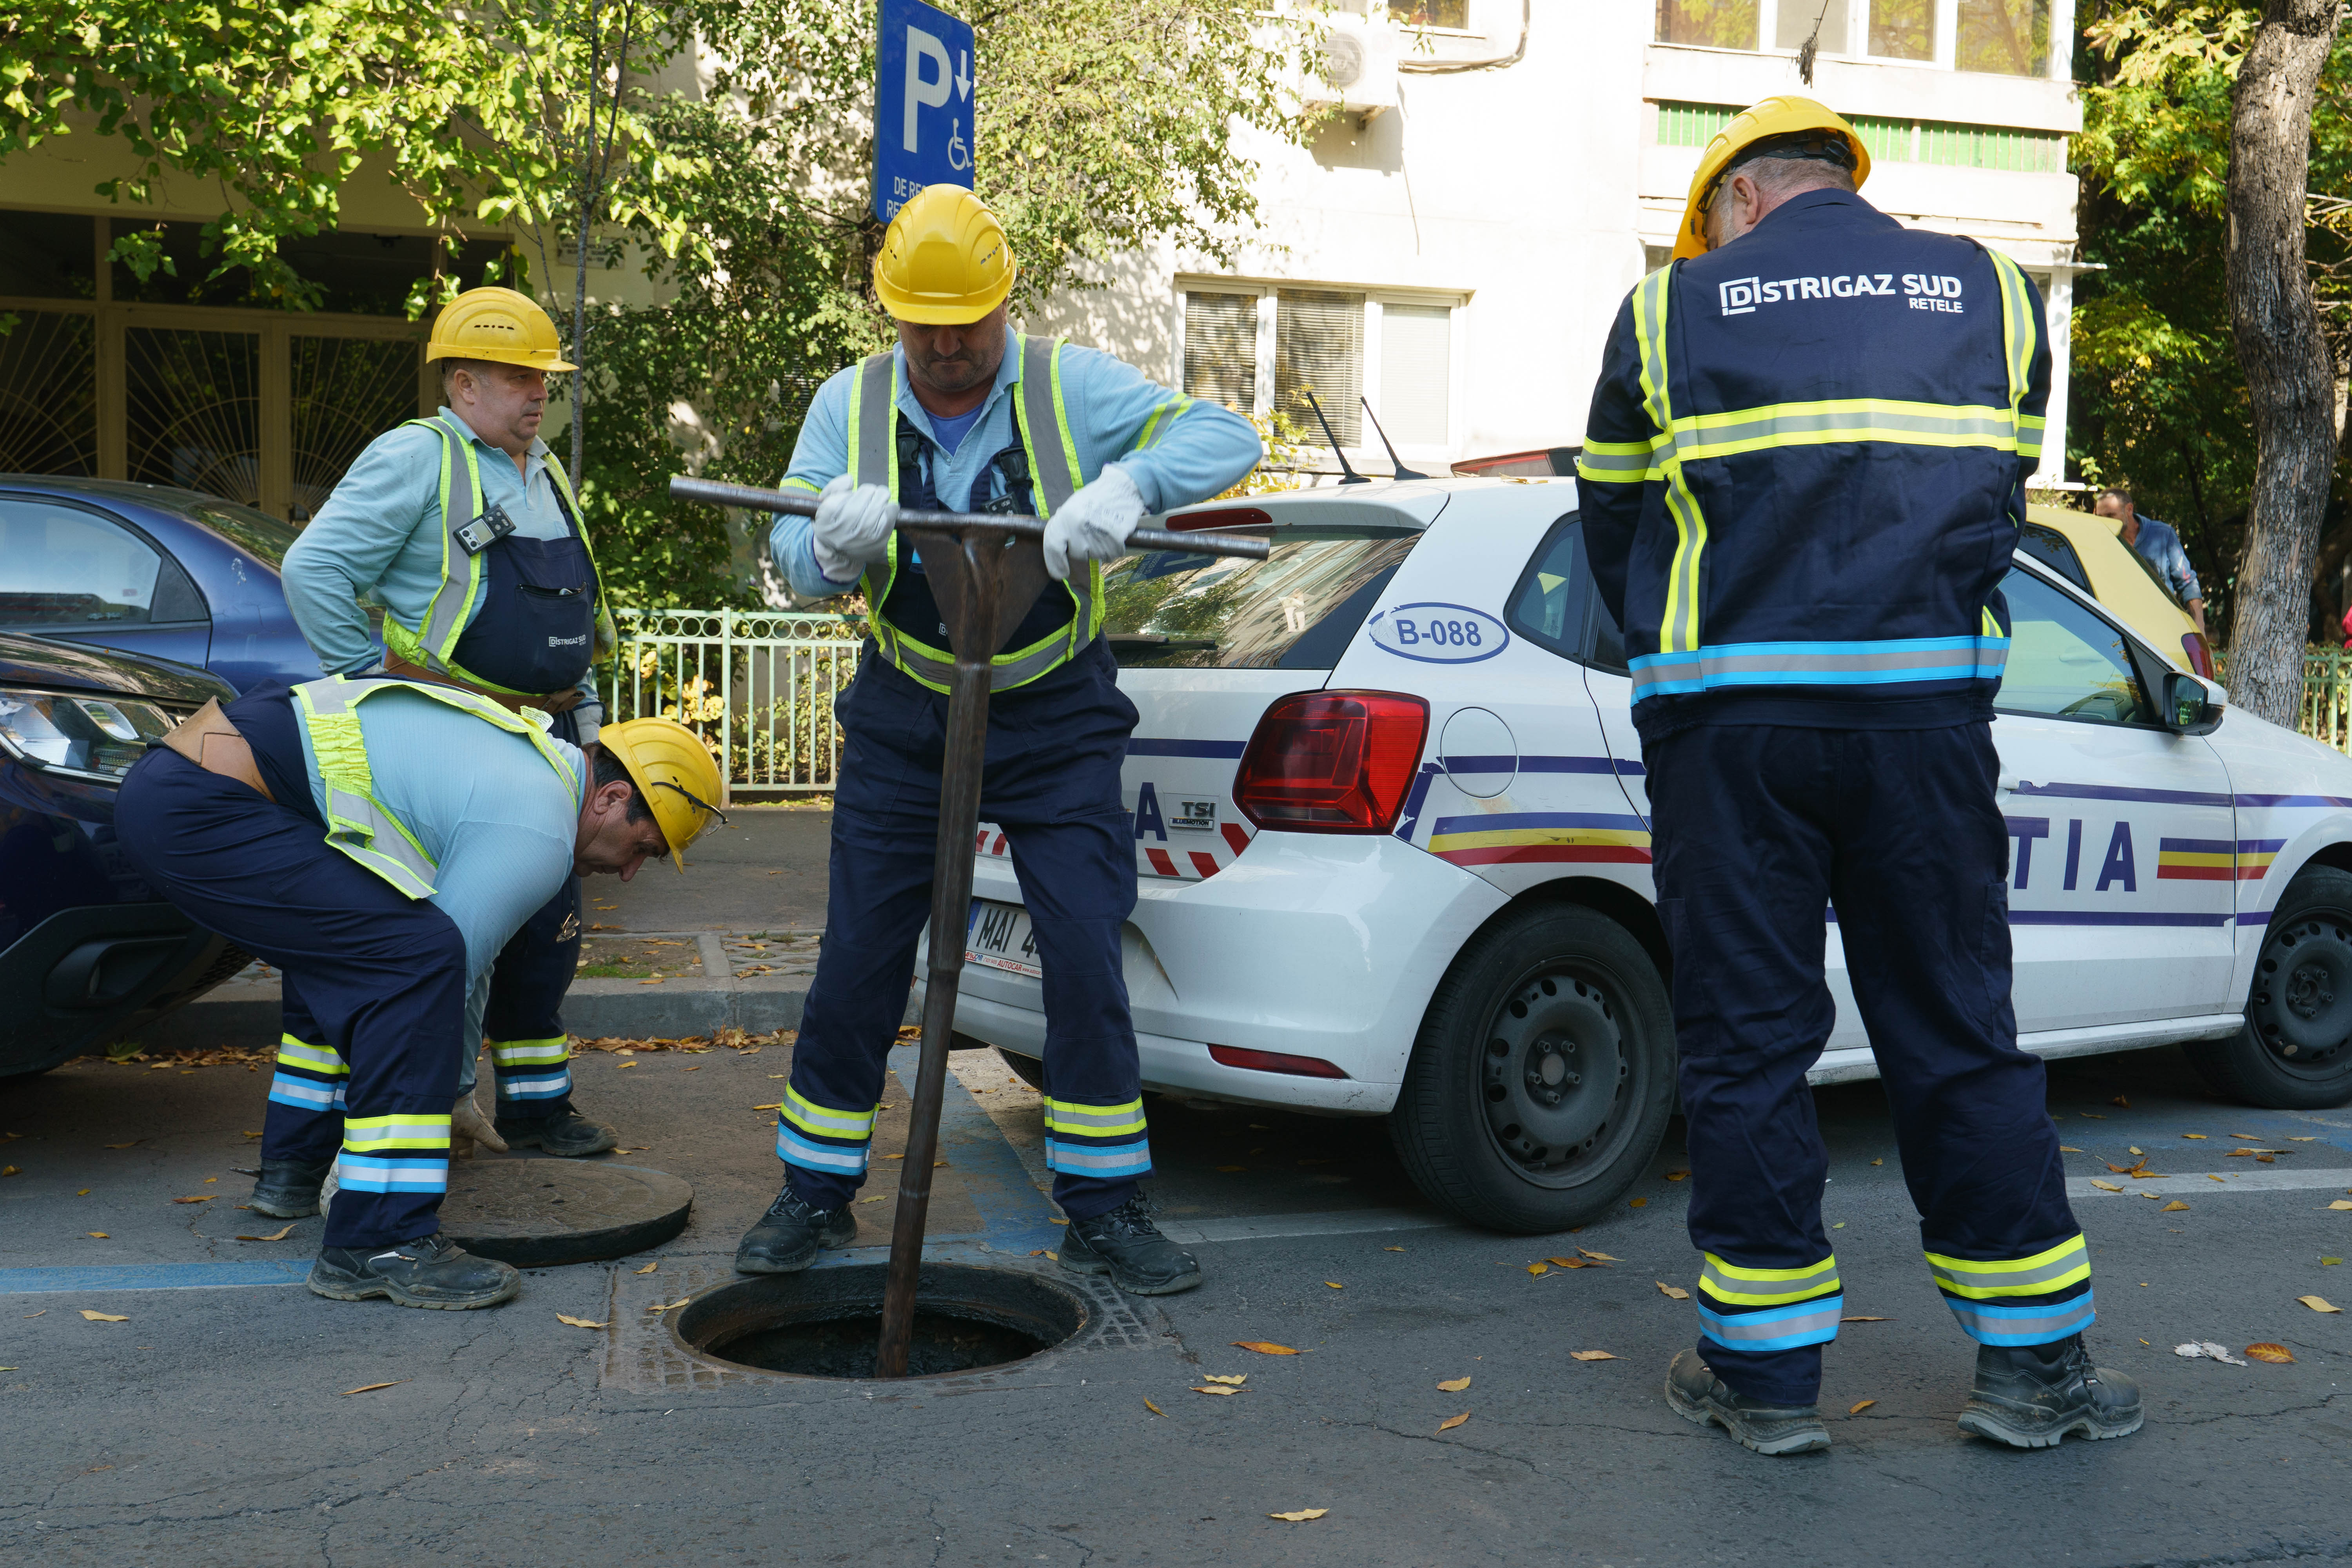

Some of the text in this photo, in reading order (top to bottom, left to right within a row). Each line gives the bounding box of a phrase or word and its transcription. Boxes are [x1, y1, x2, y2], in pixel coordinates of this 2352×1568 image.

[904, 24, 952, 153] P
[894, 176, 926, 198] DE RE
[886, 199, 904, 219] RE
[1902, 274, 1962, 298] SUD
[1909, 298, 1964, 313] RETELE
[1396, 619, 1482, 646] B-088
[1181, 800, 1216, 817] TSI
[2004, 815, 2136, 892] TIA
[976, 908, 1018, 953] MAI
[997, 960, 1022, 971] AUTOCAR
